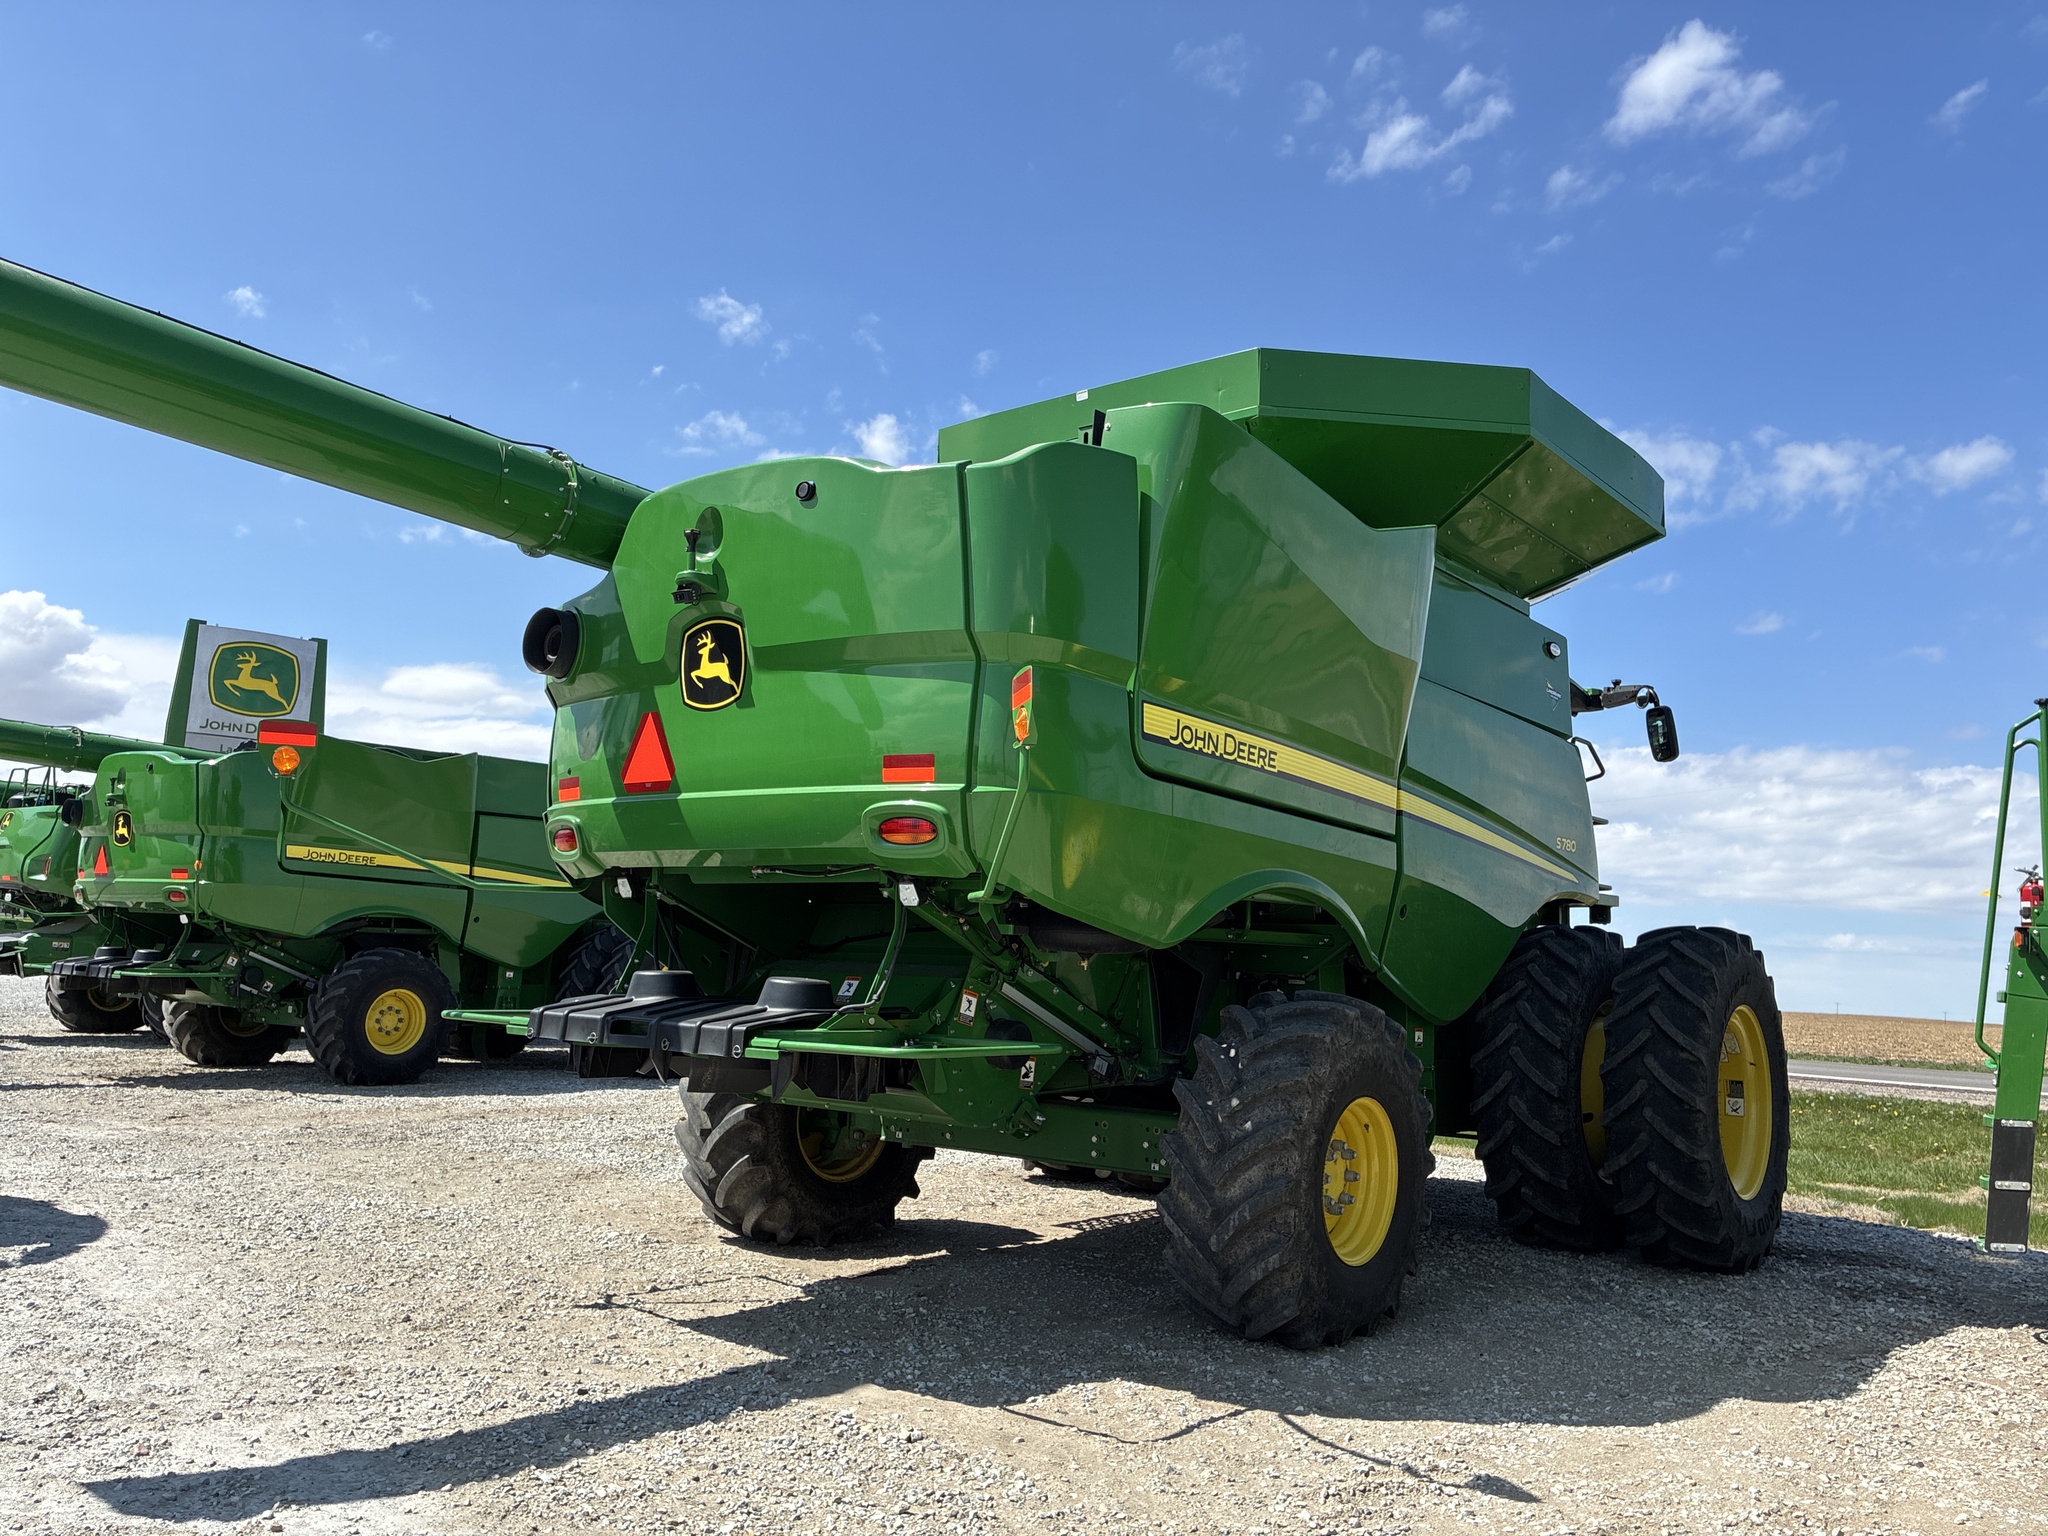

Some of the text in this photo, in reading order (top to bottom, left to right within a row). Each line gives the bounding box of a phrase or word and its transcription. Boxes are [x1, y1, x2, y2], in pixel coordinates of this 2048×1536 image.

[199, 718, 243, 733] JOHN
[1169, 718, 1278, 770] JOHN DEERE
[303, 848, 377, 865] JOHN DEERE
